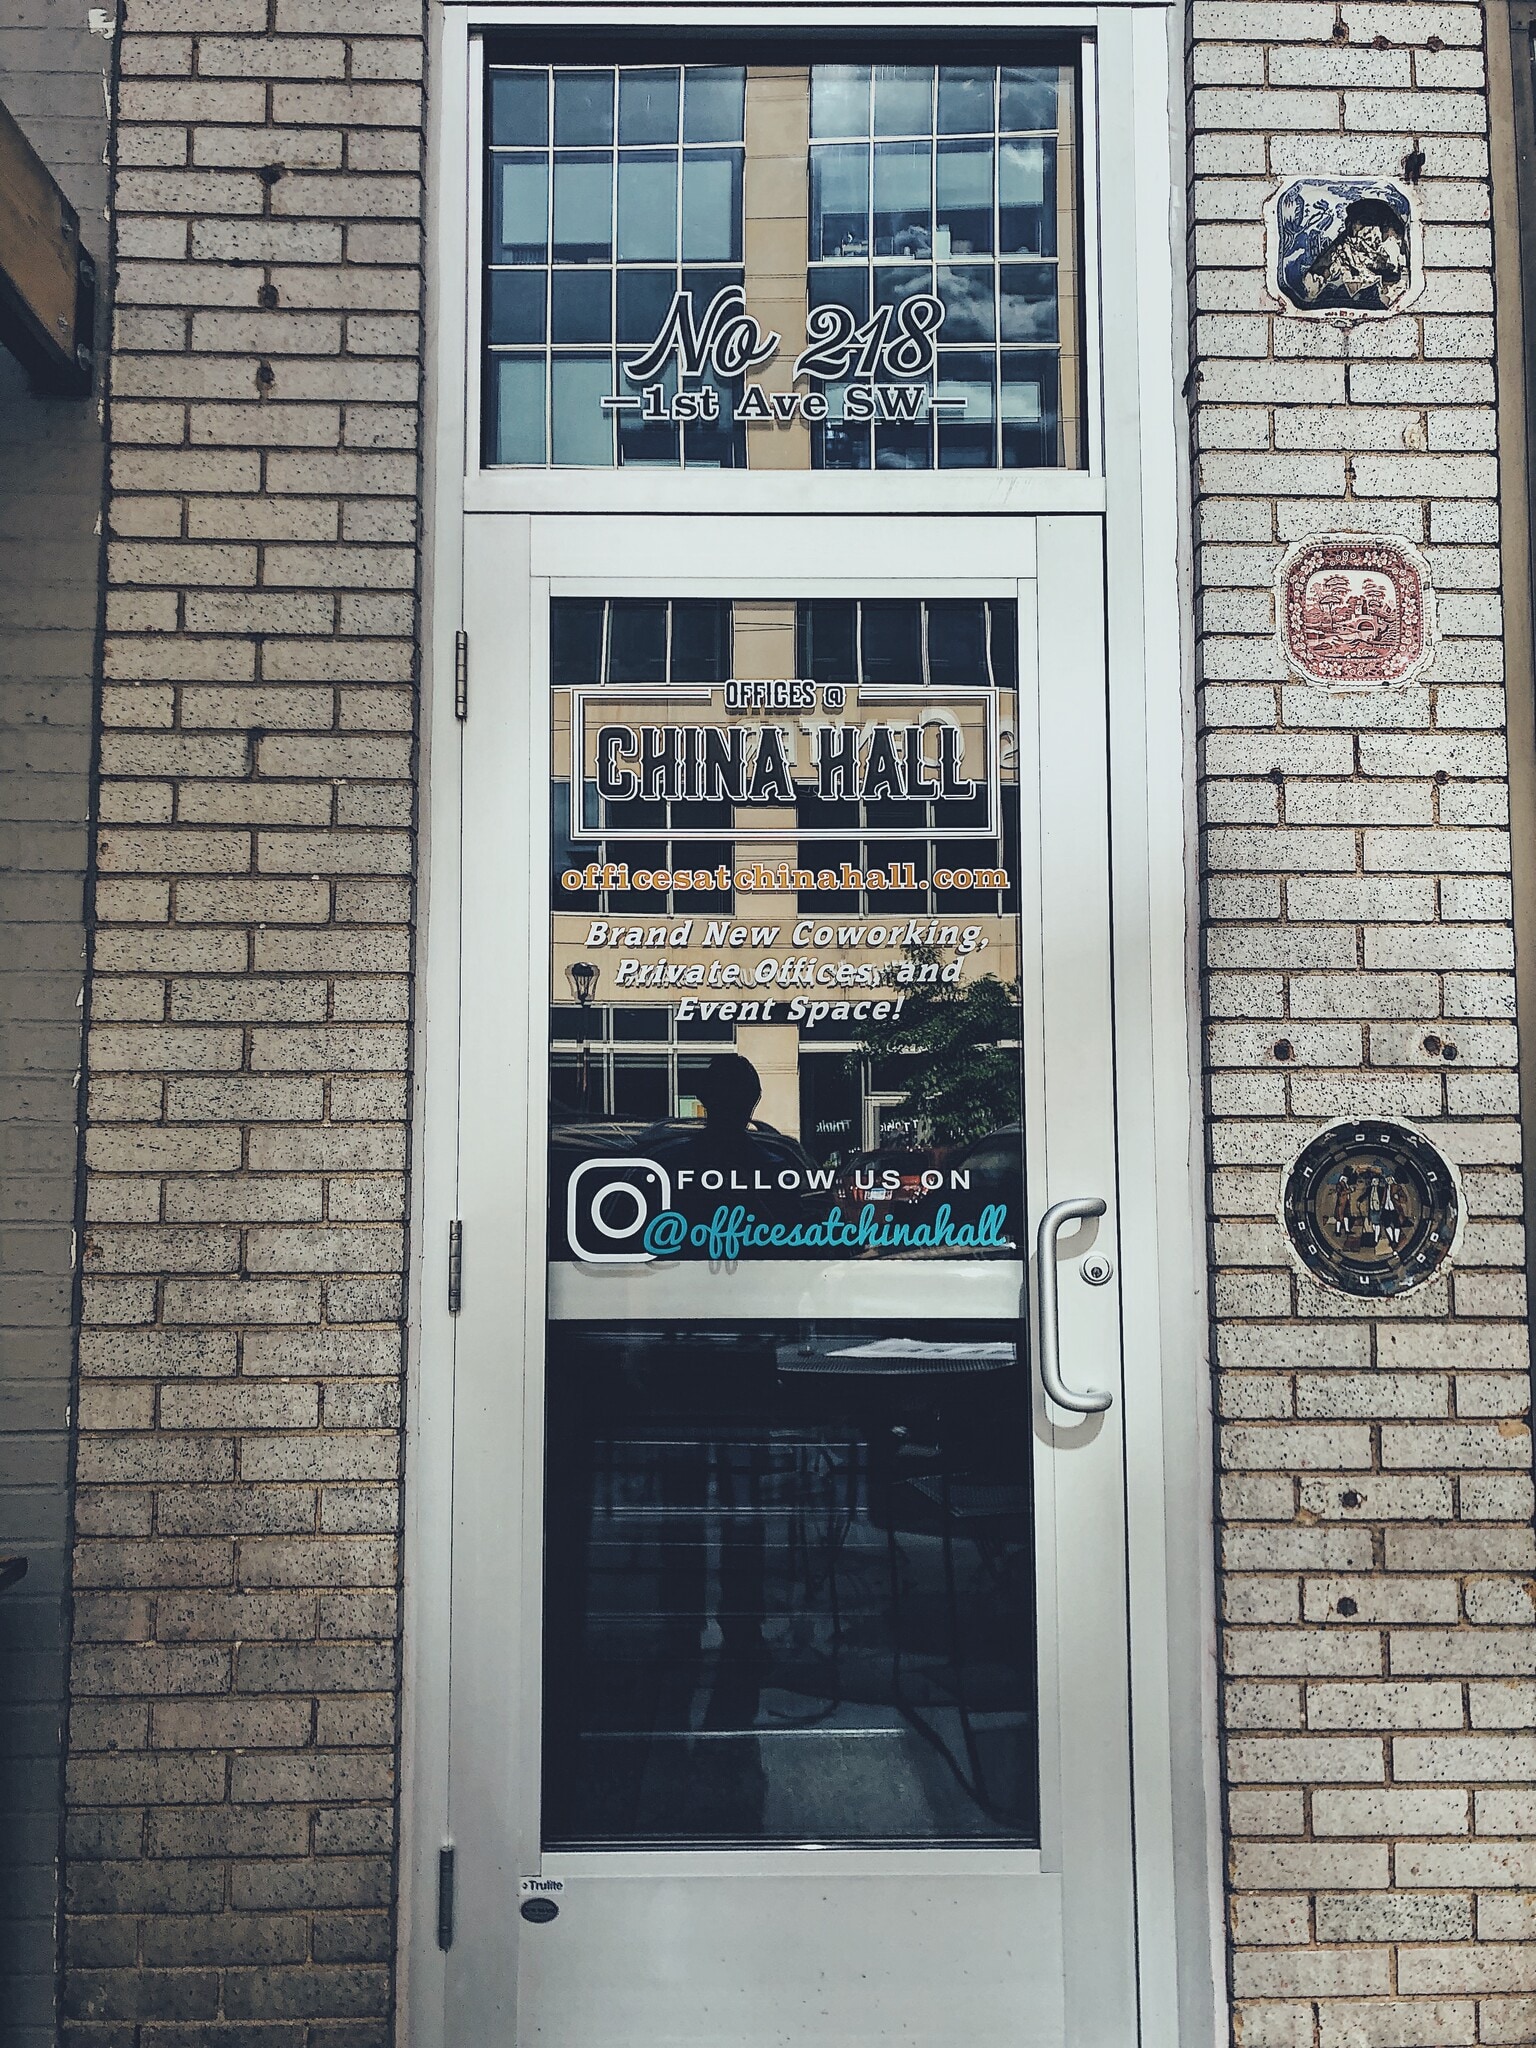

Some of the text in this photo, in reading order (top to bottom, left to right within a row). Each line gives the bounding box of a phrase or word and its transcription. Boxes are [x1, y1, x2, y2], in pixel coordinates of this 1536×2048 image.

[623, 285, 946, 382] No 218
[734, 384, 829, 421] Ave
[725, 679, 817, 709] OFFICES
[595, 724, 797, 801] CHINA
[818, 724, 977, 801] HALL
[561, 862, 1011, 891] officesatchinahall.com
[584, 920, 990, 954] Brand New Coworking,
[614, 958, 741, 985] Private
[753, 957, 880, 988] Offices,
[896, 956, 966, 983] and
[674, 995, 906, 1028] Event Space!
[677, 1169, 971, 1190] FOLLOW US ON
[643, 1203, 1008, 1260] @officesatchinahall
[528, 1879, 564, 1891] Trulite
